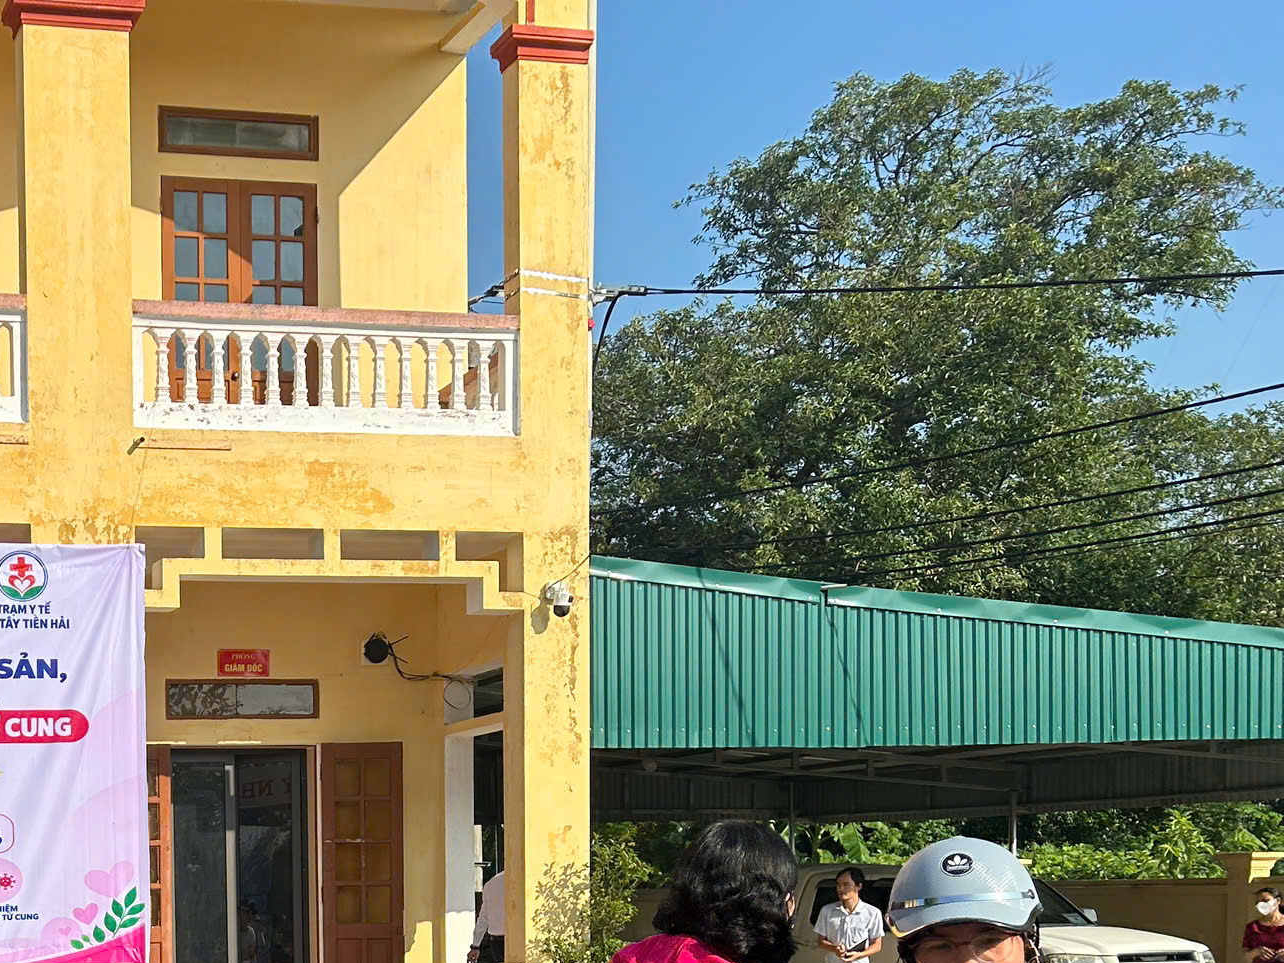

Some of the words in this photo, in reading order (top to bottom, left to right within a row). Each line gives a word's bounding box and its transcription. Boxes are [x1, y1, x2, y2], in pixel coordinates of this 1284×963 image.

[28, 604, 36, 614] Y
[38, 601, 51, 614] TẾ
[0, 616, 20, 629] TÂY
[22, 614, 48, 629] TIỀN
[50, 615, 70, 629] HẢI
[225, 661, 245, 672] GIÁM
[247, 661, 263, 672] ĐỐC
[4, 717, 72, 738] CUNG
[14, 913, 40, 921] CUNG
